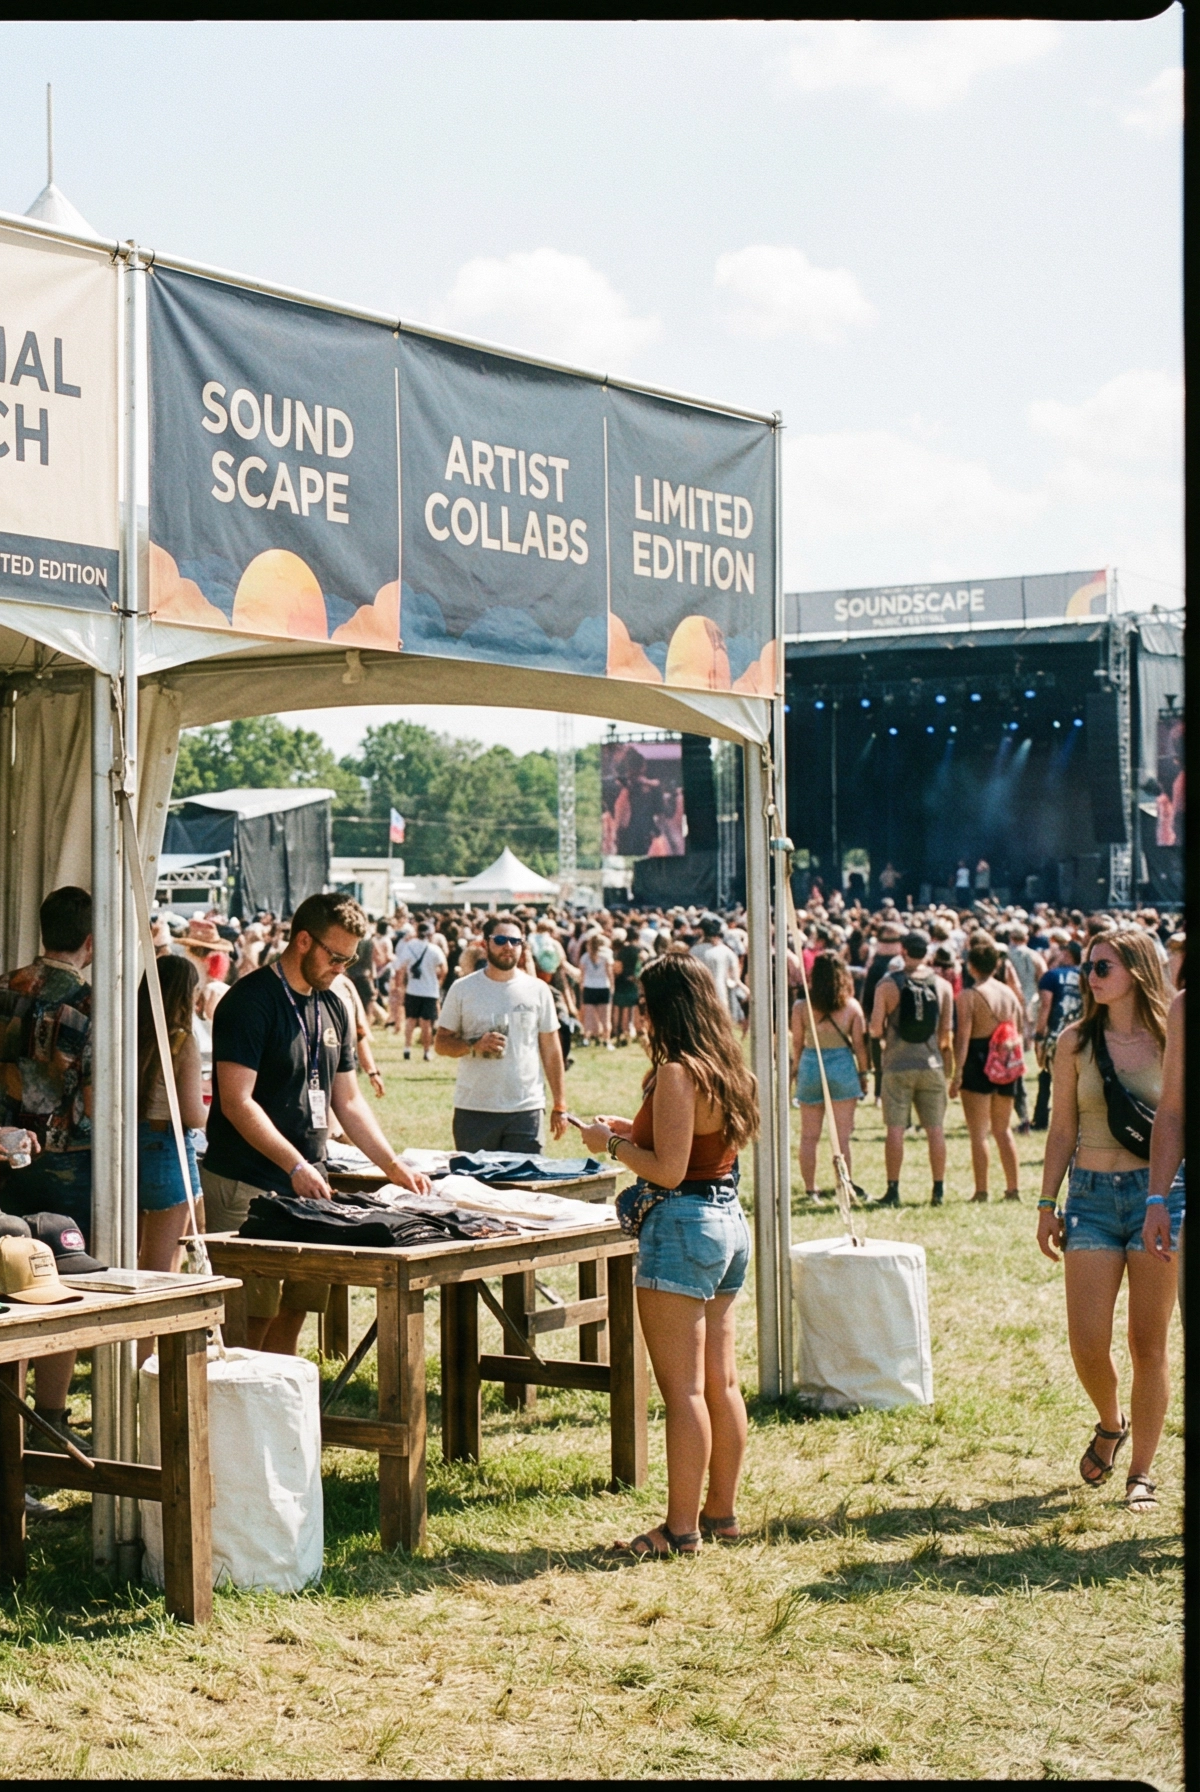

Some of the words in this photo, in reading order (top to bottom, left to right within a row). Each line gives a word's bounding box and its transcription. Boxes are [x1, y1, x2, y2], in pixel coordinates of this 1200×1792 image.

[200, 380, 355, 460] SOUND
[210, 450, 350, 526] SCAPE
[443, 434, 570, 503] ARTIST
[424, 492, 589, 566] COLLABS
[634, 474, 754, 540] LIMITED
[39, 558, 108, 588] EDITION
[633, 531, 756, 595] EDITION
[833, 587, 986, 623] SOUNDSCAPE
